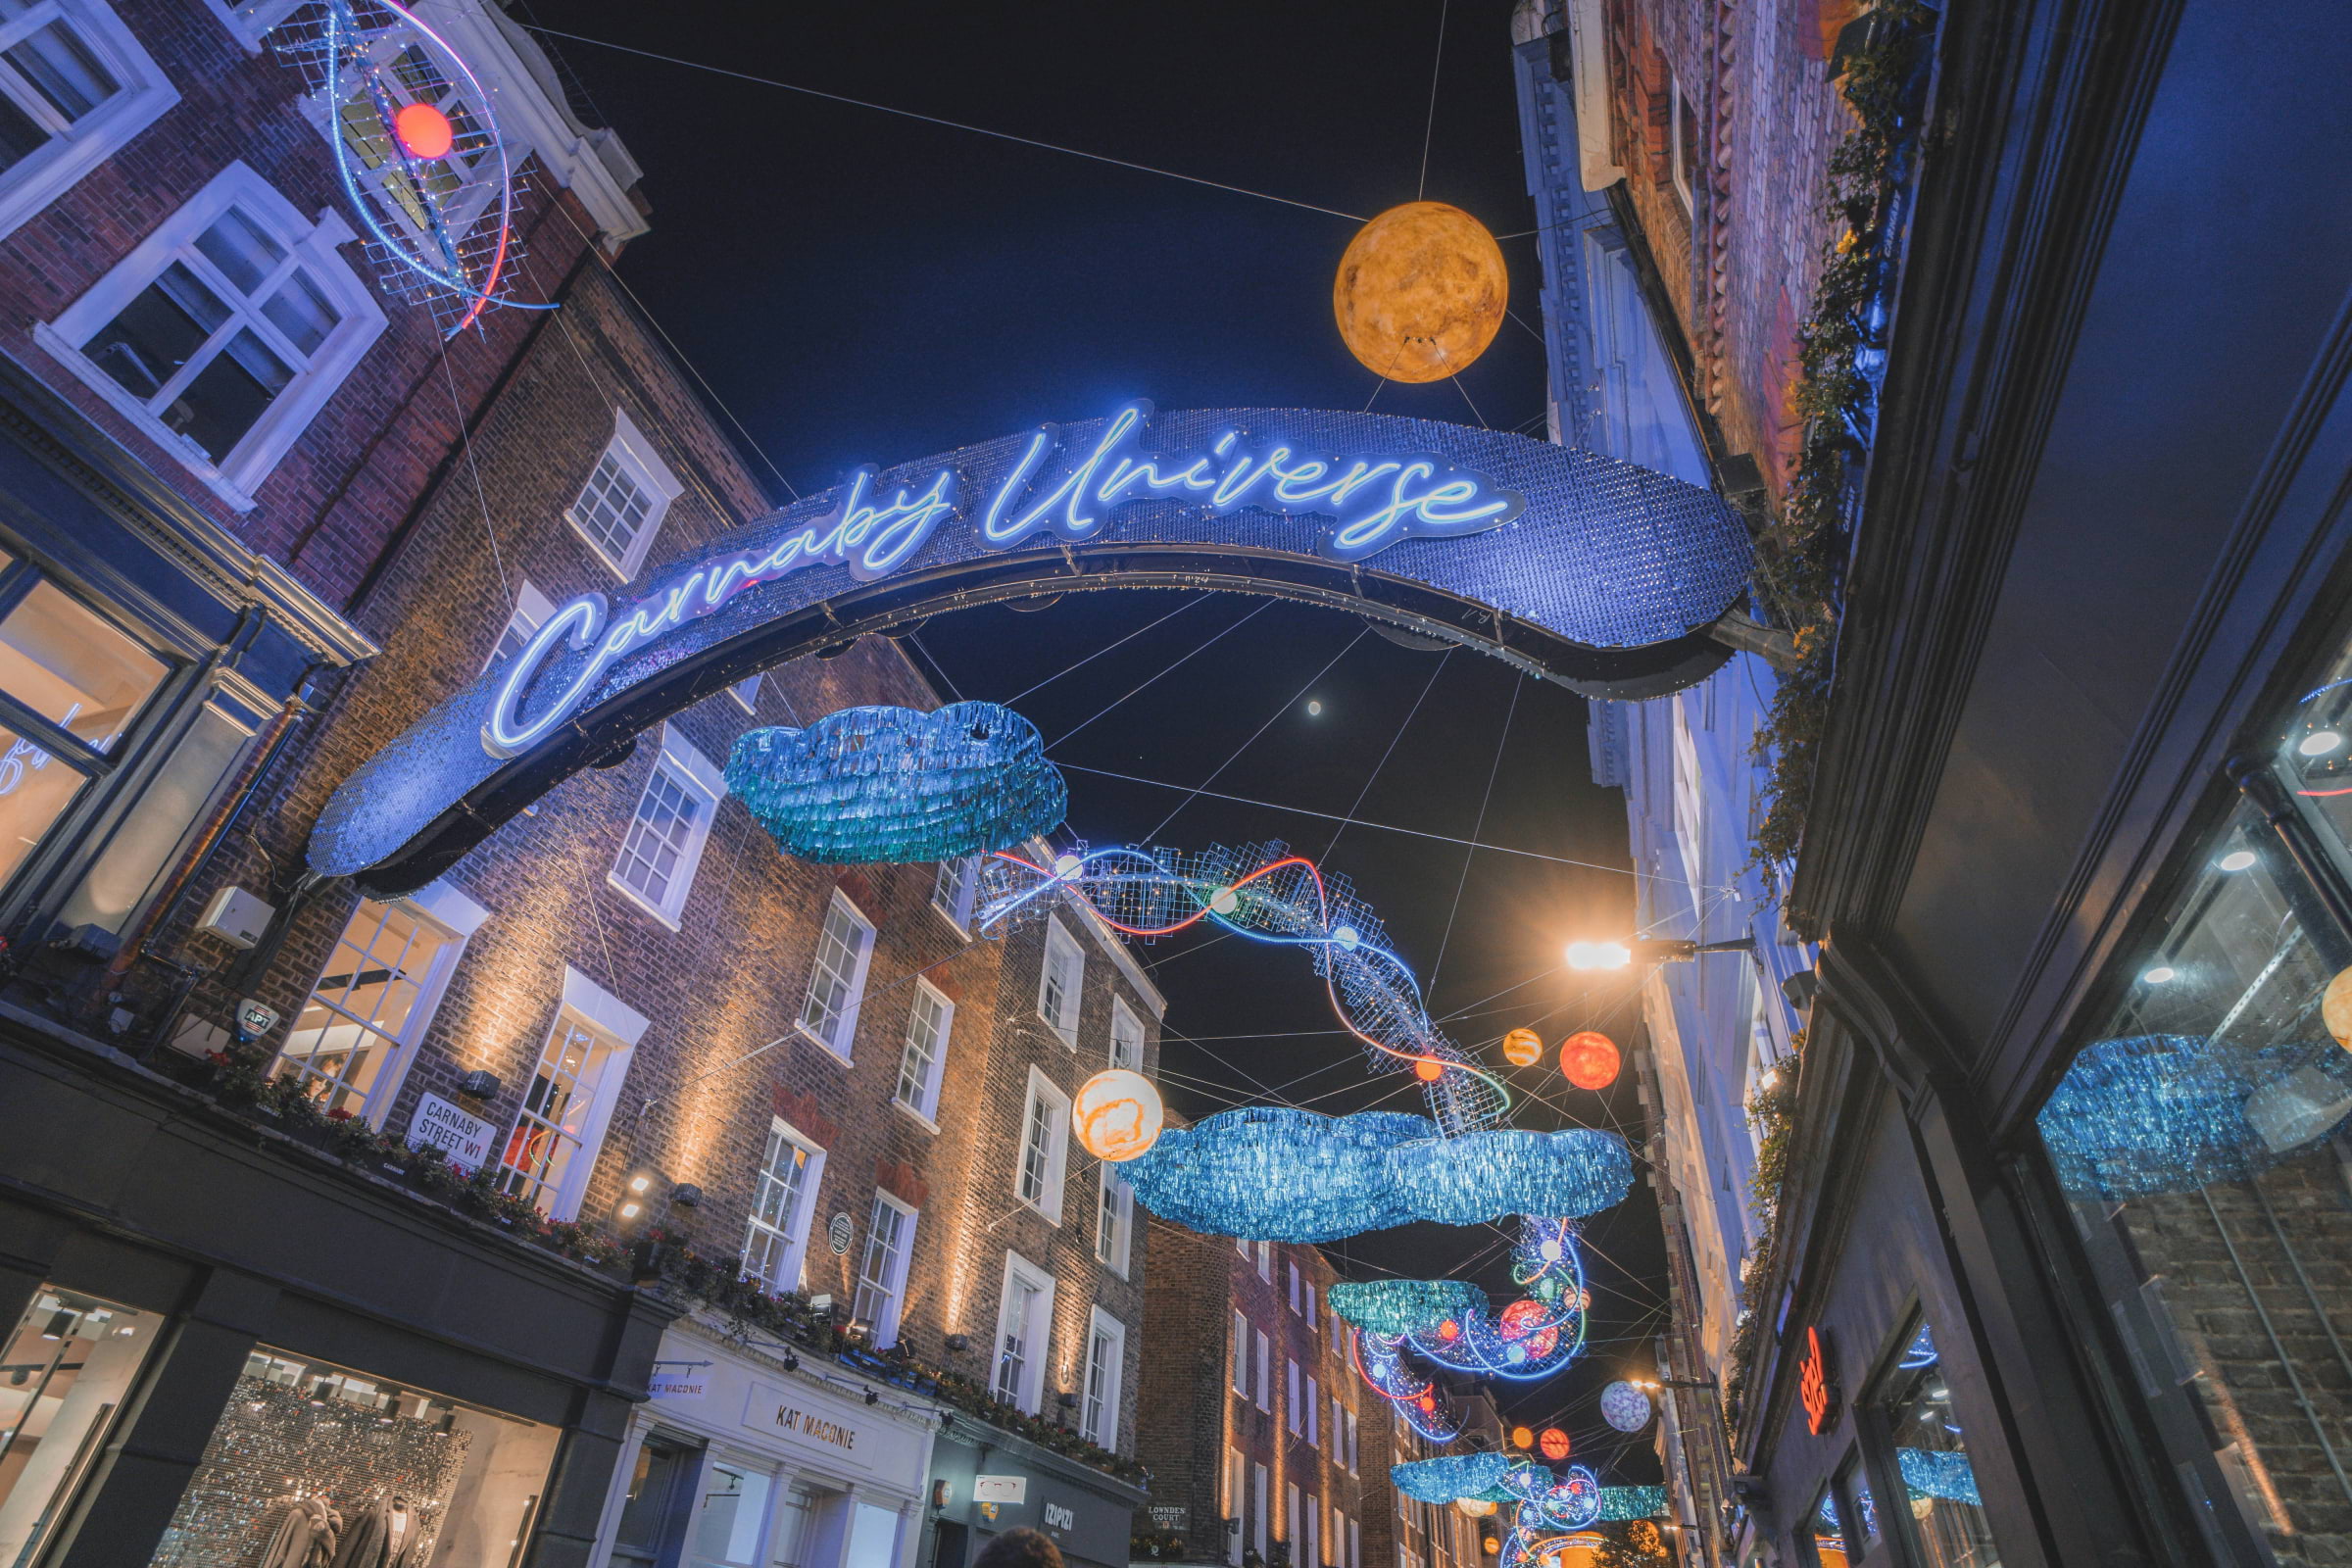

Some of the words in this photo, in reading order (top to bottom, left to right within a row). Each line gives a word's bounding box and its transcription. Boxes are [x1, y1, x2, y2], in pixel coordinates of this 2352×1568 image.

[482, 468, 954, 749] Carnaby
[984, 404, 1510, 549] Universe
[246, 1011, 270, 1027] APT
[426, 1102, 482, 1139] CARNABY
[418, 1118, 465, 1151] STREET
[465, 1140, 482, 1159] W1
[664, 1383, 704, 1395] MACONIE
[776, 1404, 802, 1432] KAT
[803, 1414, 856, 1450] MACONIE
[1045, 1502, 1073, 1532] IZIPIZI
[1148, 1505, 1186, 1514] LOWNDES
[1152, 1513, 1180, 1522] COURT
